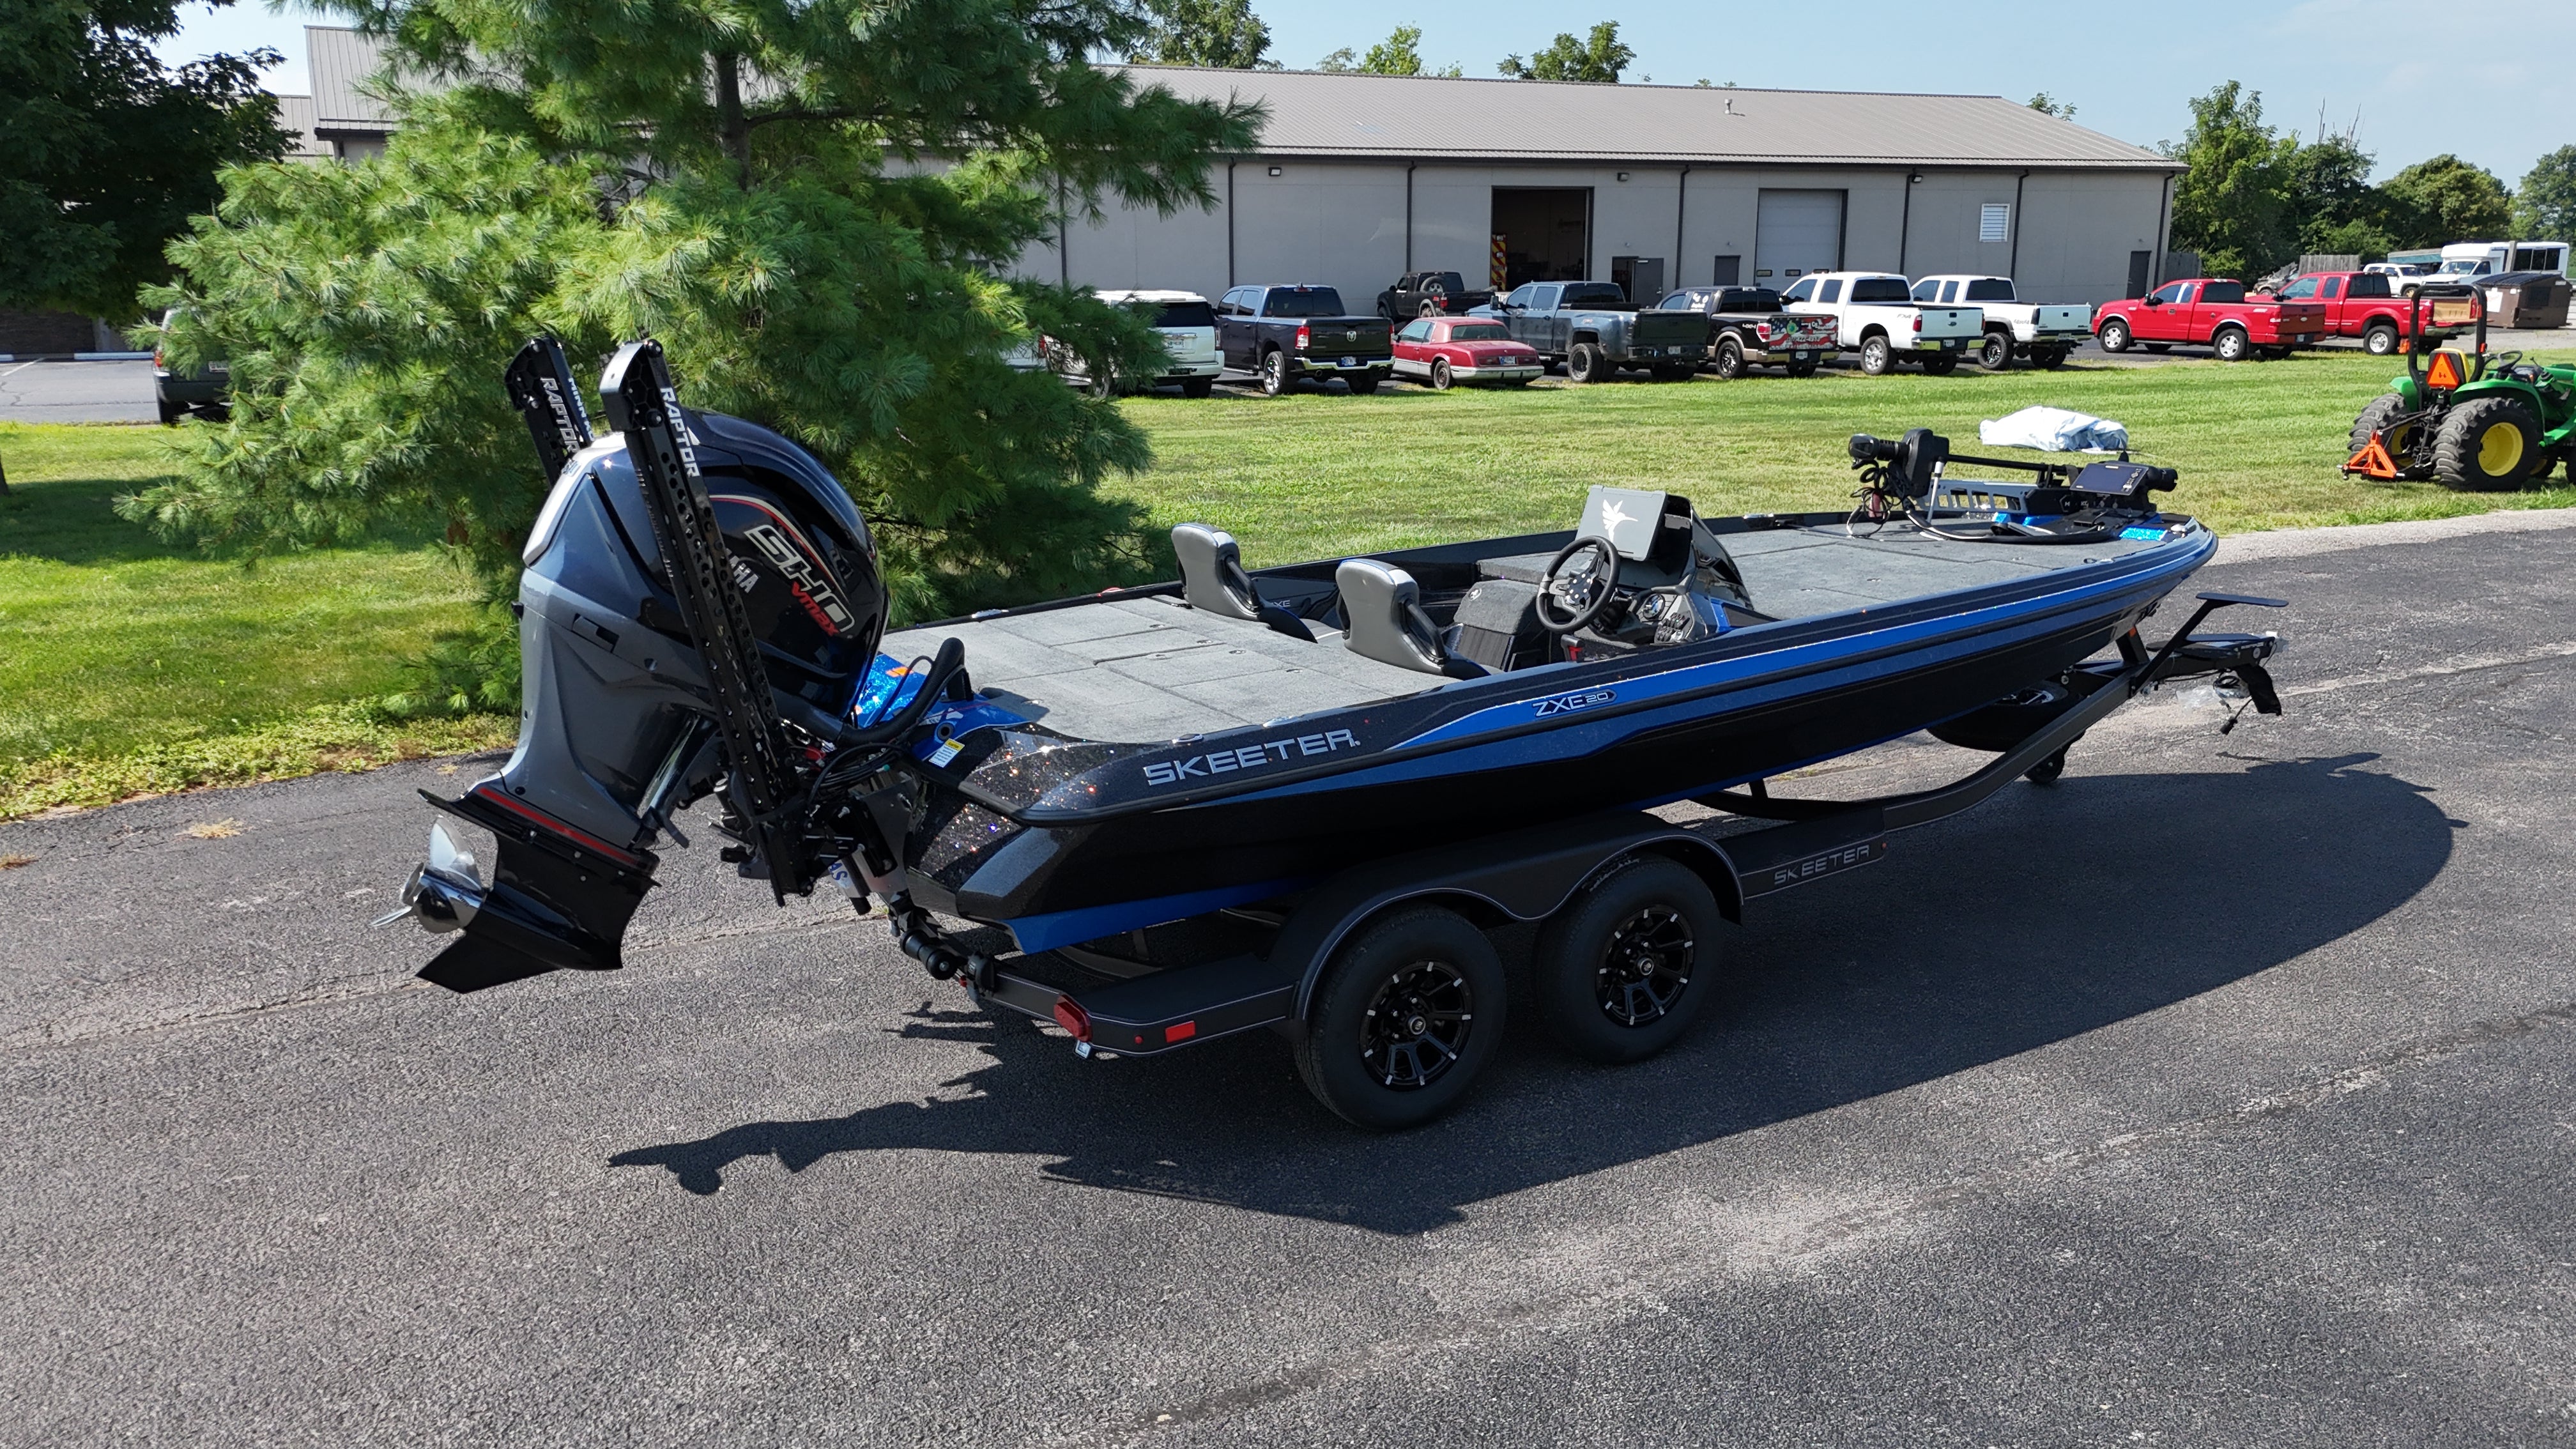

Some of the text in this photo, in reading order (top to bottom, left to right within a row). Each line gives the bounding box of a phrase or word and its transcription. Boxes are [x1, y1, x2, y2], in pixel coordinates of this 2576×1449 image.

[540, 377, 580, 453] RAPTOR
[567, 377, 587, 418] MINN
[659, 387, 700, 477] RAPTOR
[744, 525, 855, 632] SHO
[1533, 692, 1609, 716] ZXE 20
[1143, 728, 1359, 786] SKEETER
[1774, 845, 1869, 885] SKEETER
